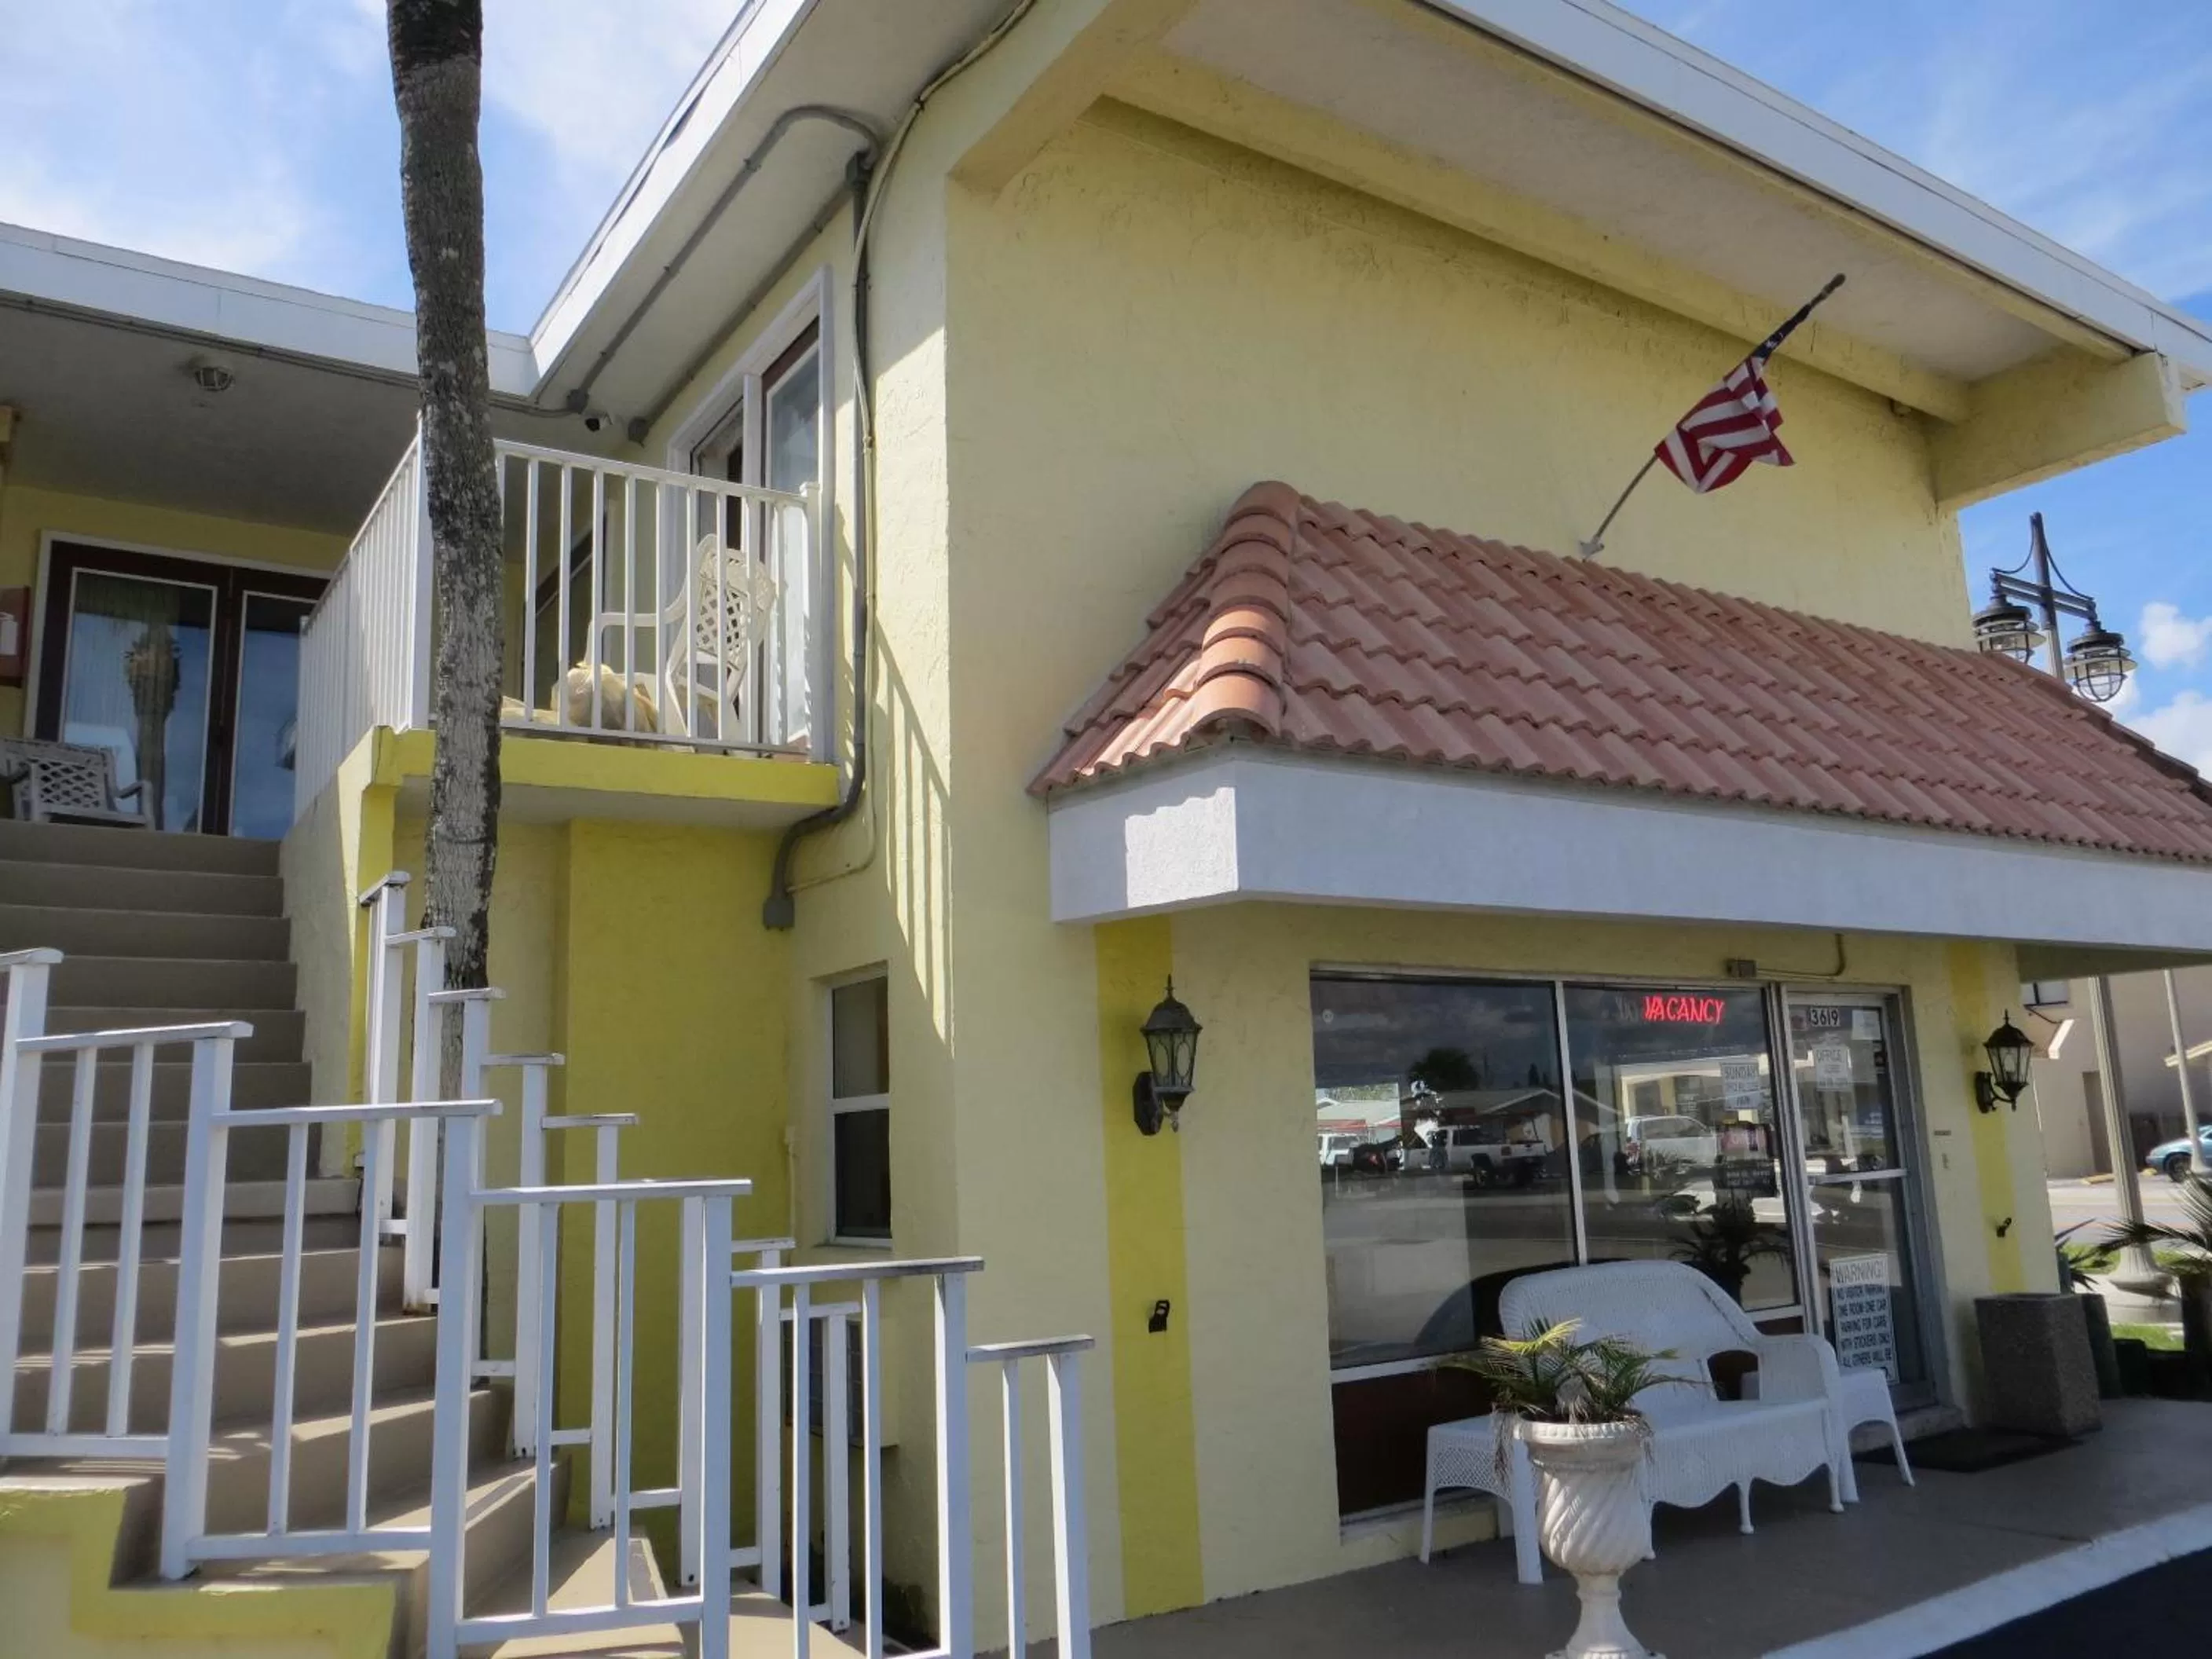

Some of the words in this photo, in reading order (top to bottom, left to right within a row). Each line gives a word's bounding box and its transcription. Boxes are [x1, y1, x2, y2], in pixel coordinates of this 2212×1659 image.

[1644, 995, 1724, 1024] VACANCY
[1811, 1007, 1840, 1026] 3619
[1837, 1261, 1884, 1284] WARNING!
